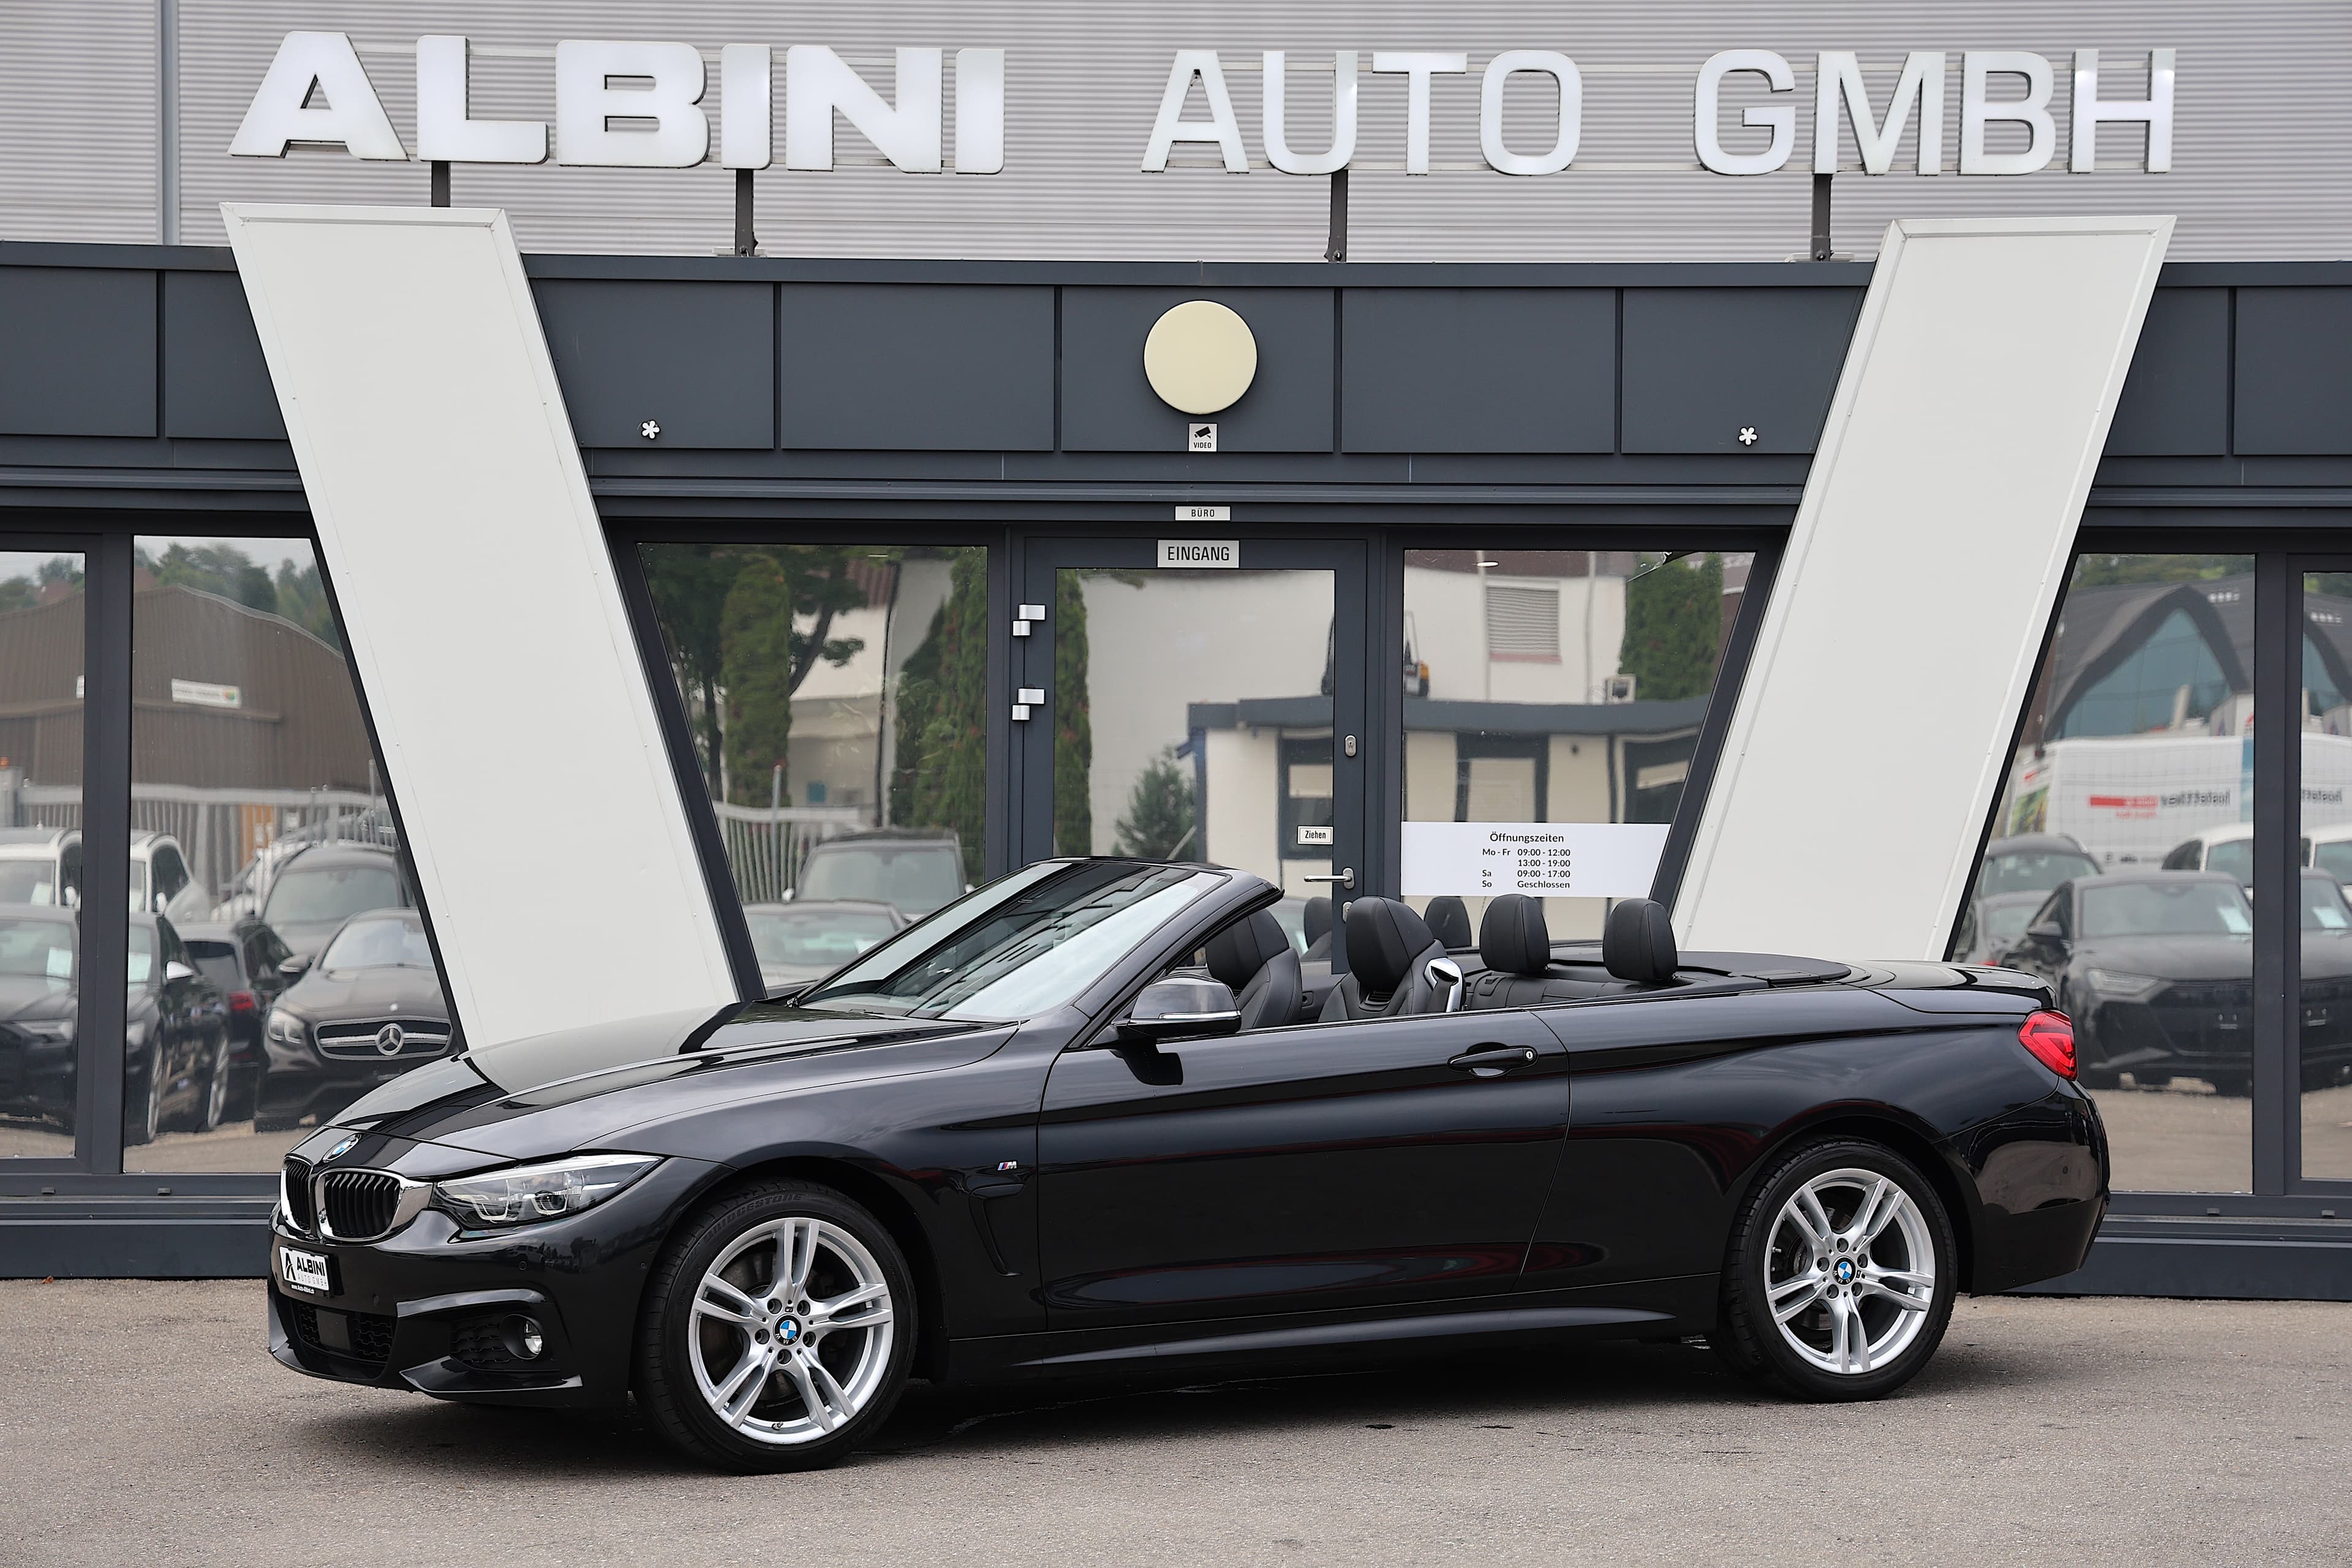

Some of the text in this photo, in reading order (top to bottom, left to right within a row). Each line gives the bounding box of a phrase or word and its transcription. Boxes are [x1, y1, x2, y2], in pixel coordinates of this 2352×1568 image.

[227, 31, 2177, 176] ALBINI AUTO GMBH
[1191, 507, 1215, 518] BÜRO
[1167, 546, 1230, 561] EINGANG
[1305, 830, 1326, 839] Ziehen
[1490, 831, 1564, 844] Öffnungszeiten
[297, 1256, 325, 1276] ALBINI
[775, 1332, 798, 1344] BMW
